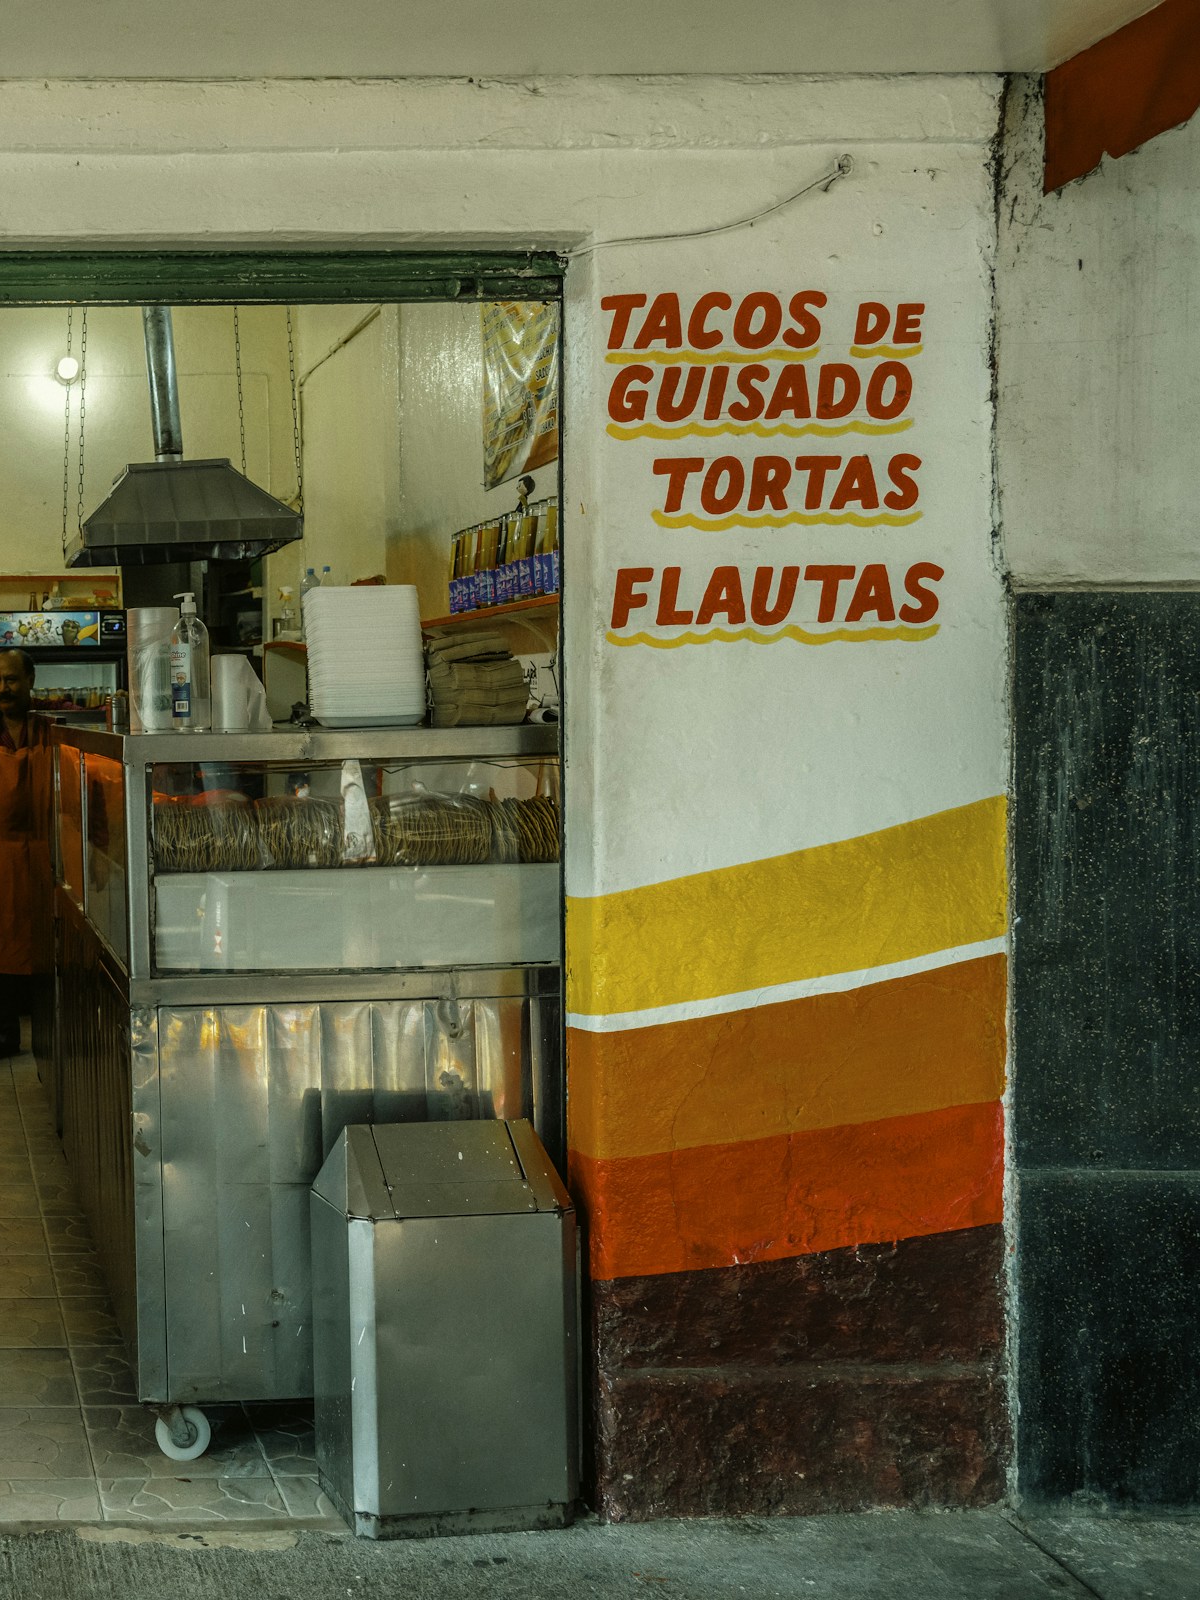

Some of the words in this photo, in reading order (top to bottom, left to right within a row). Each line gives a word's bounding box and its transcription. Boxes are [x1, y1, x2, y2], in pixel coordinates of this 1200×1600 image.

[600, 290, 827, 350] TACOS
[853, 302, 925, 345] DE
[607, 361, 913, 423] GUISADO
[653, 453, 922, 515] TORTAS
[611, 562, 944, 629] FLAUTAS
